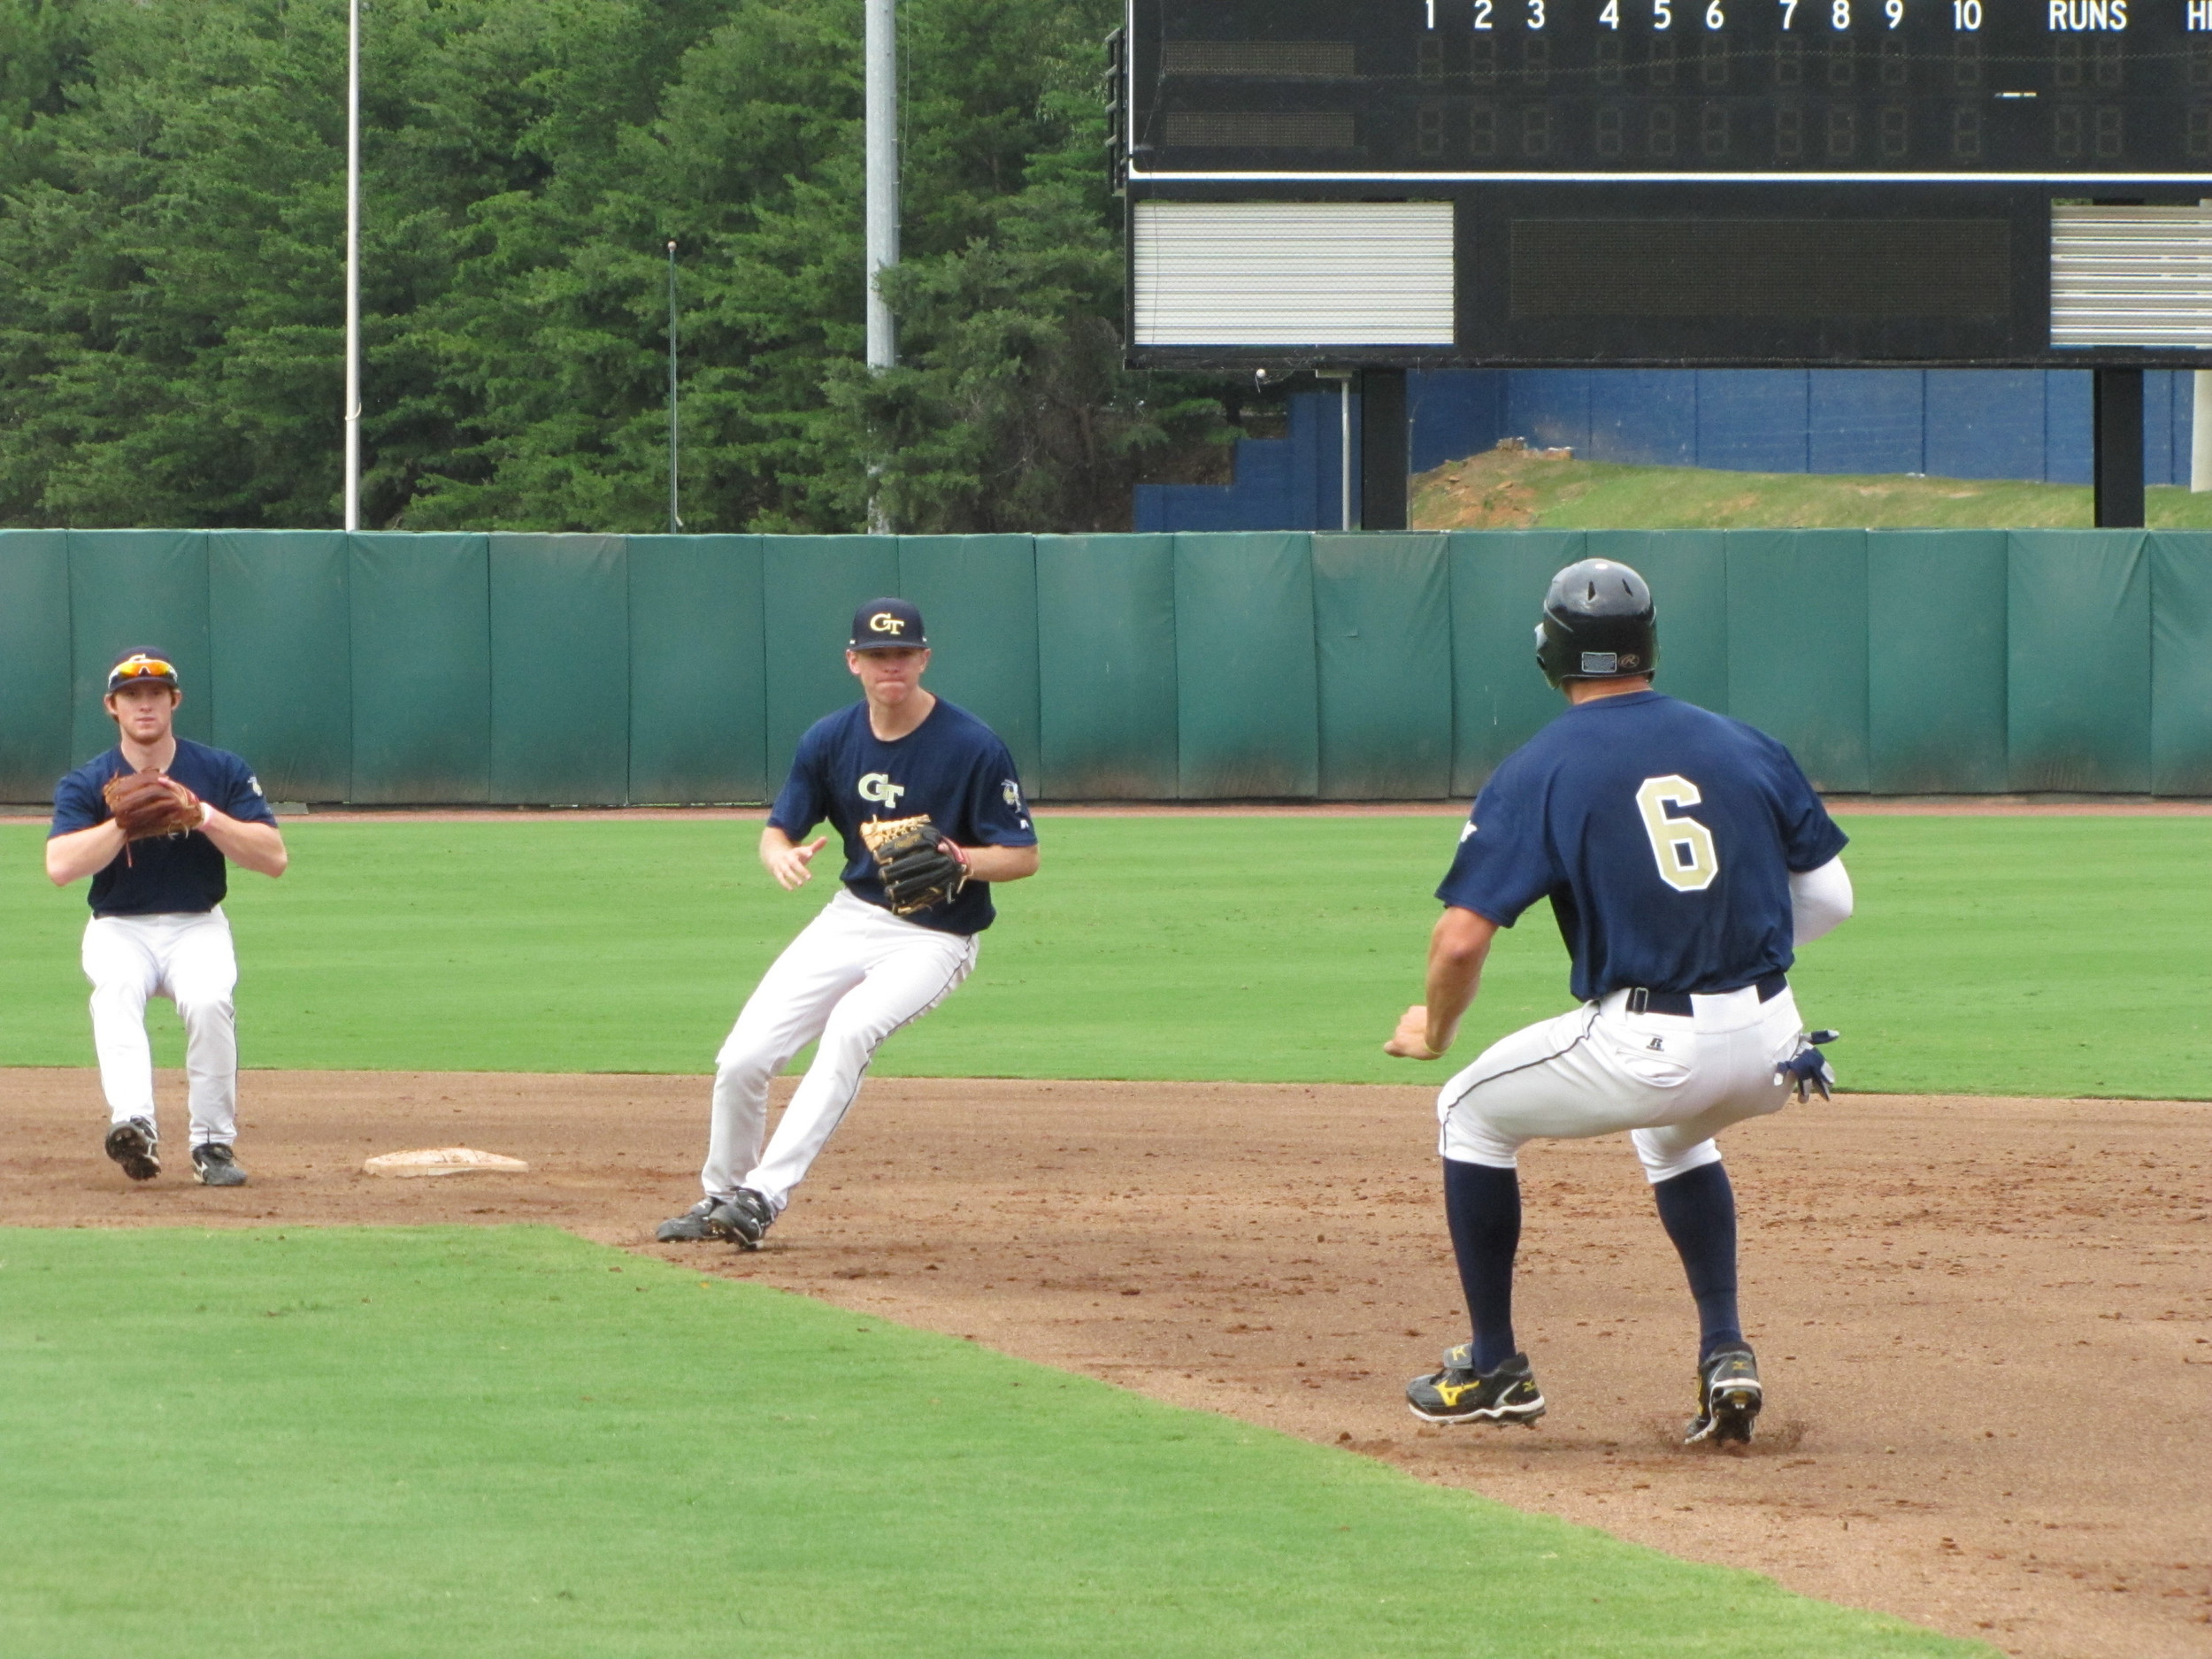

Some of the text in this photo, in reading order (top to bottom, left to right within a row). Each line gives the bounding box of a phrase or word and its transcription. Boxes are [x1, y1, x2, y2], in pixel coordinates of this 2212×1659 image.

[1425, 0, 1434, 29] 1
[1473, 0, 1493, 29] 2
[1526, 0, 1546, 29] 3
[1599, 0, 1620, 30] 4
[1653, 0, 1672, 30] 5
[1705, 0, 1724, 30] 6
[1779, 0, 1799, 30] 7
[1832, 0, 1851, 30] 8
[1885, 0, 1904, 29] 9
[1953, 0, 1983, 30] 10
[2049, 0, 2128, 31] RUNS
[869, 611, 905, 635] GT
[857, 772, 905, 810] GT
[1635, 773, 1719, 893] 6
